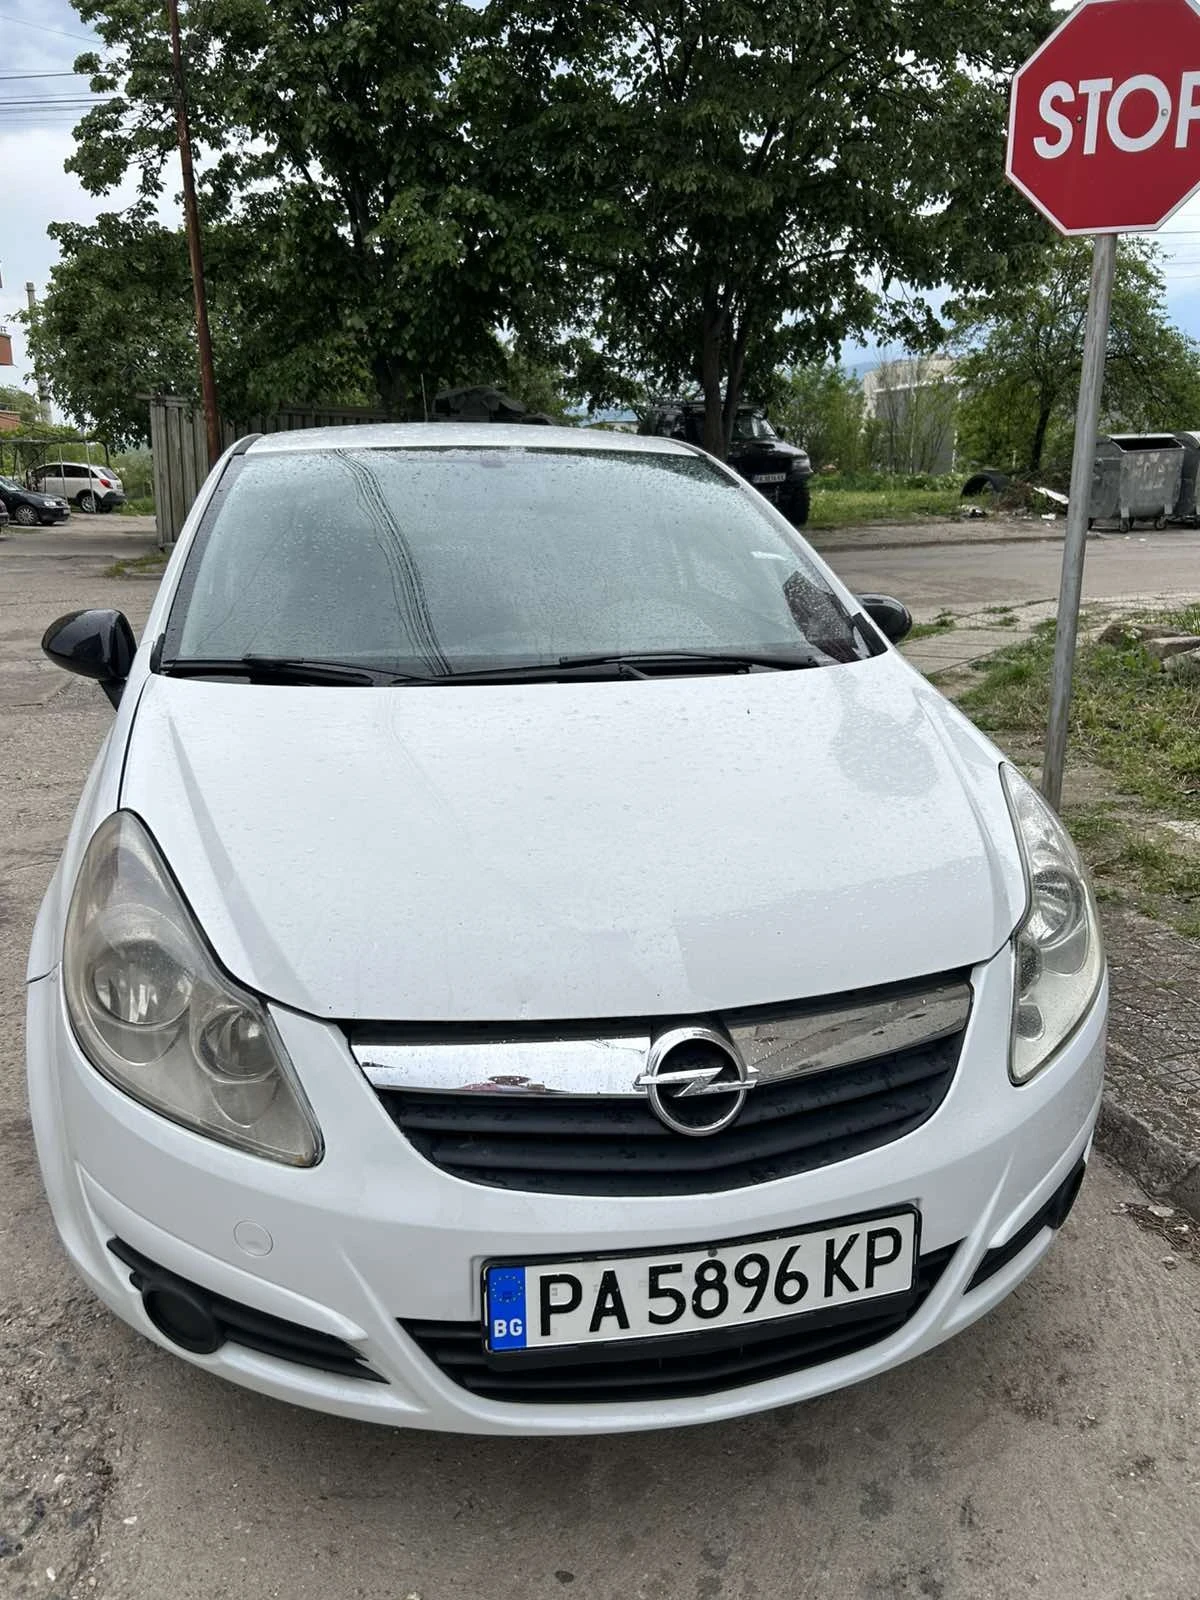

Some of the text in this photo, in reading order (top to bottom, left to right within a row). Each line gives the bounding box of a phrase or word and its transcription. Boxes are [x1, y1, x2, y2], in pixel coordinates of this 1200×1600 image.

[540, 1227, 903, 1337] PA 5896 KP
[493, 1318, 524, 1339] BG
